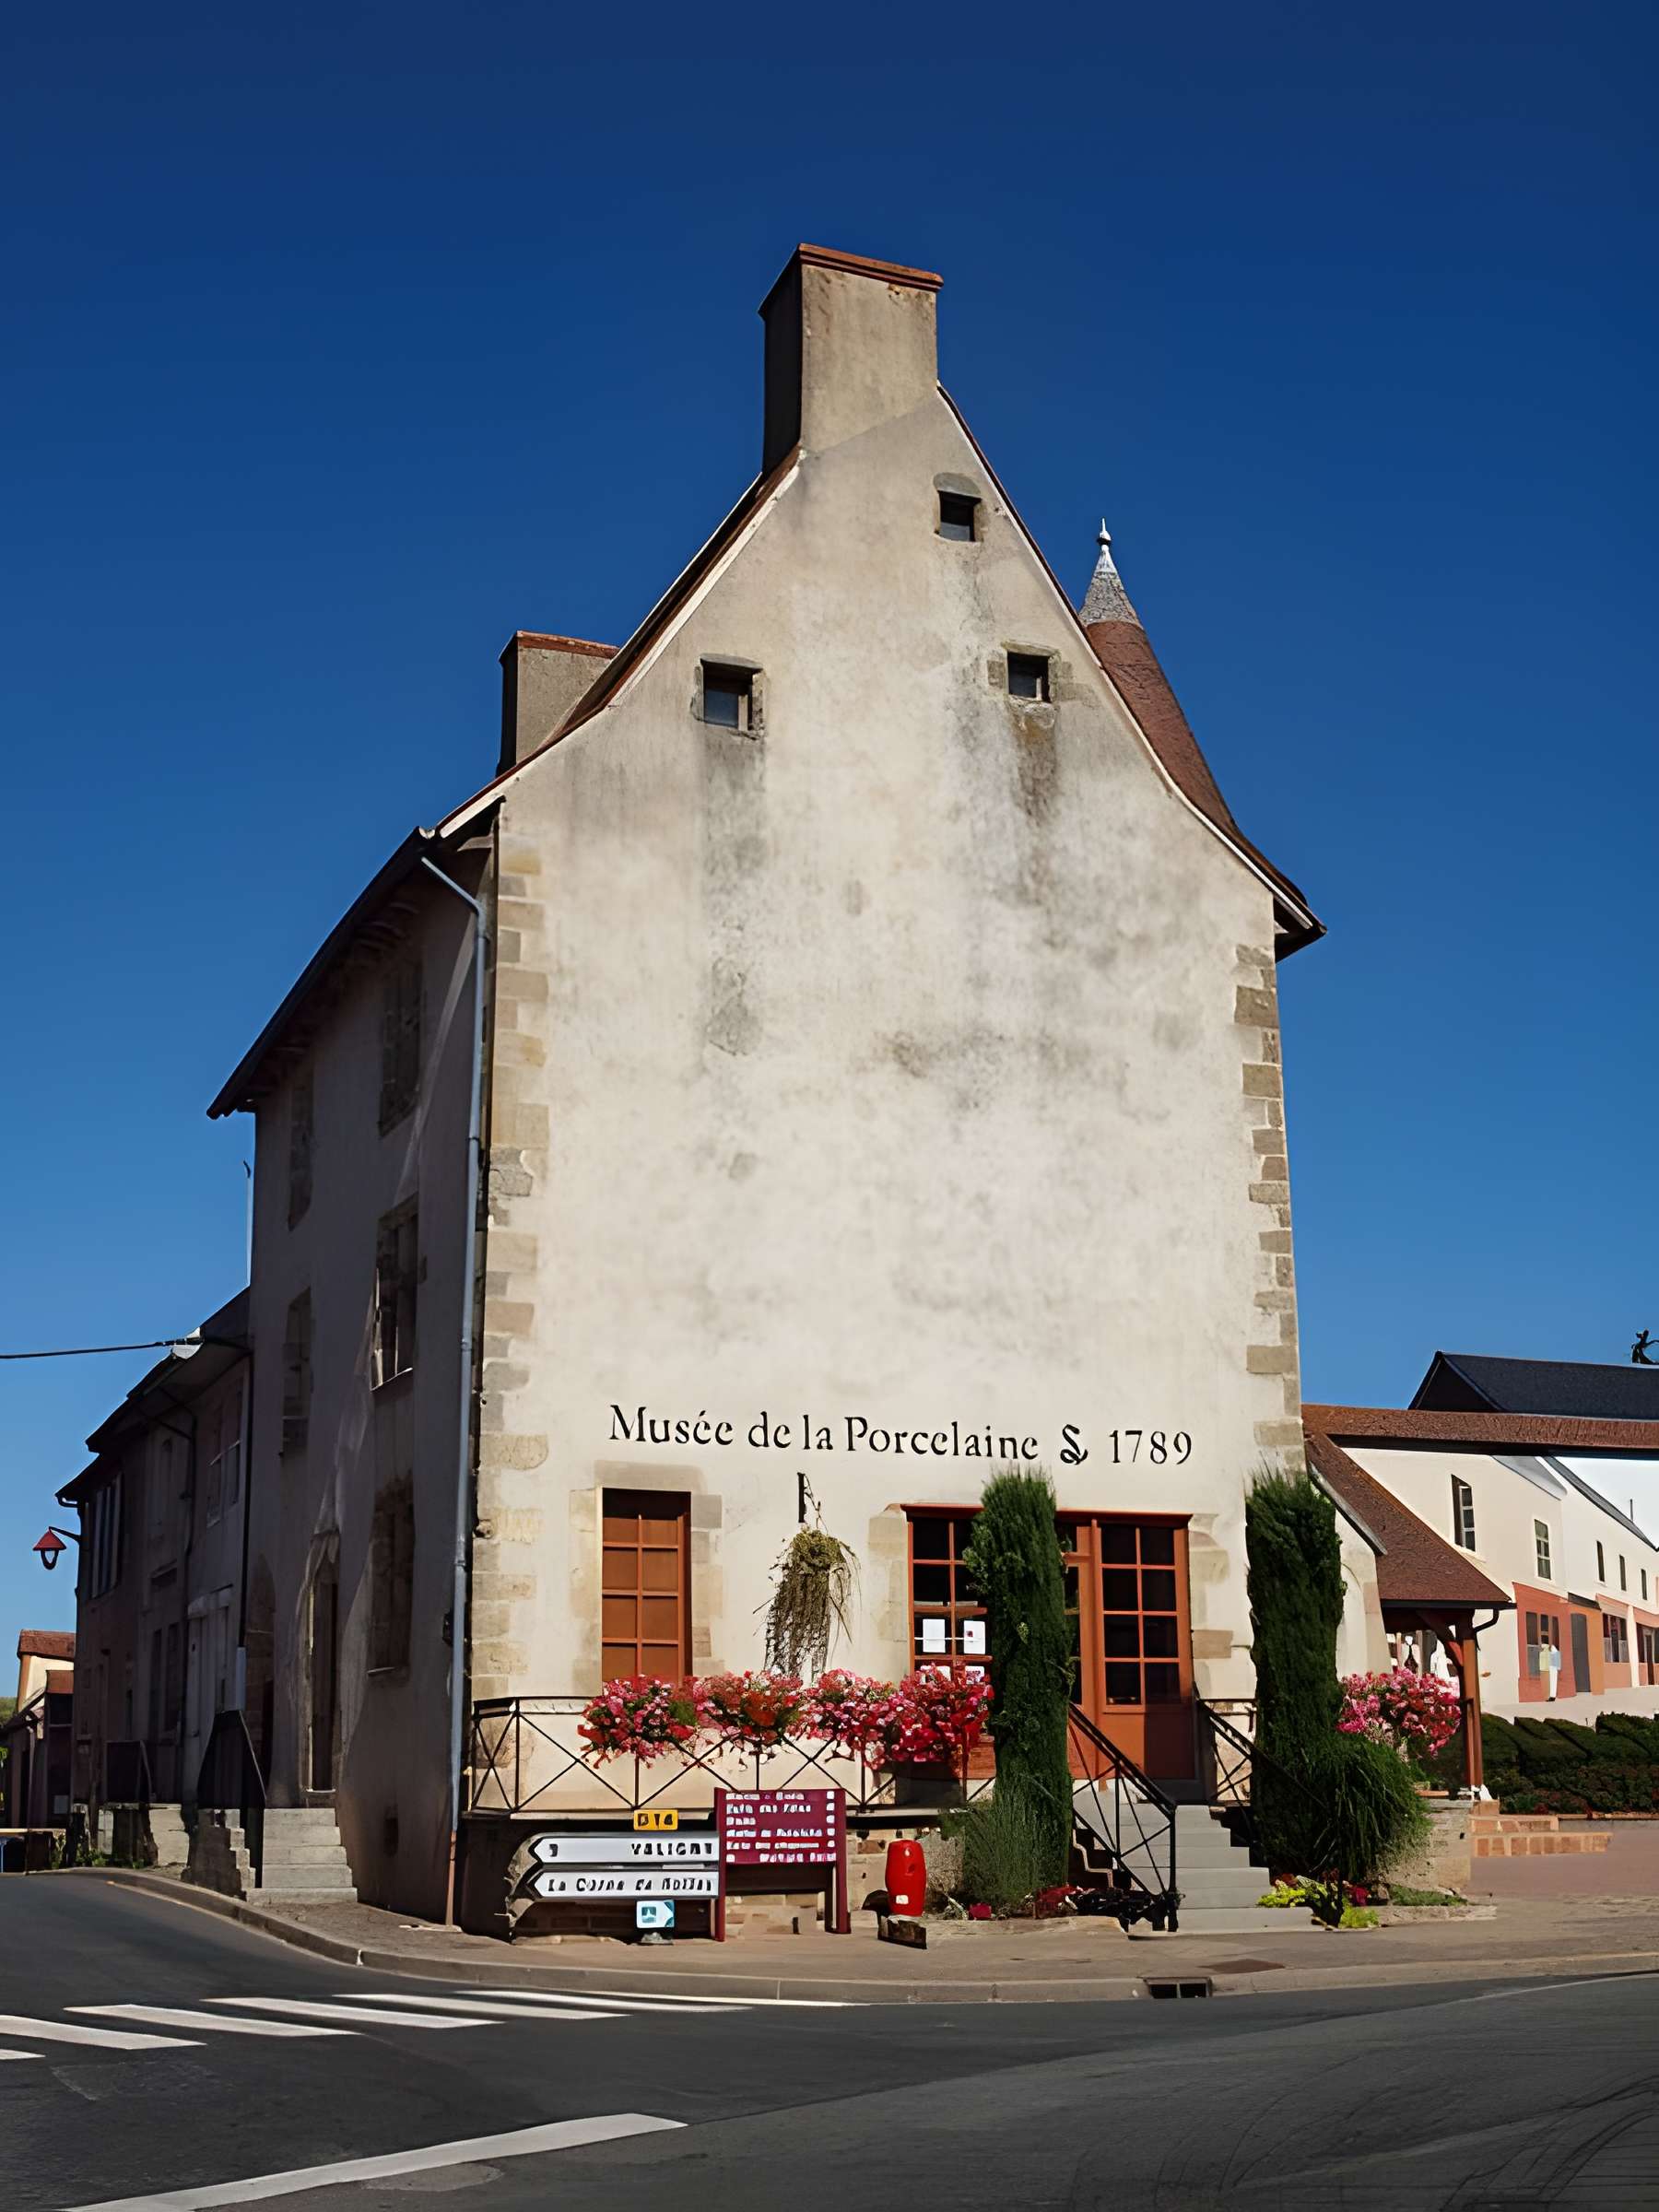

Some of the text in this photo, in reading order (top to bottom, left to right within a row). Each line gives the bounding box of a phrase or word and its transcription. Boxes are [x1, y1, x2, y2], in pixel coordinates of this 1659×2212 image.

[609, 1404, 734, 1446] Musée
[747, 1410, 792, 1449] de
[802, 1414, 833, 1451] la
[844, 1416, 1039, 1460] Porcelaine
[1108, 1430, 1192, 1465] 1789
